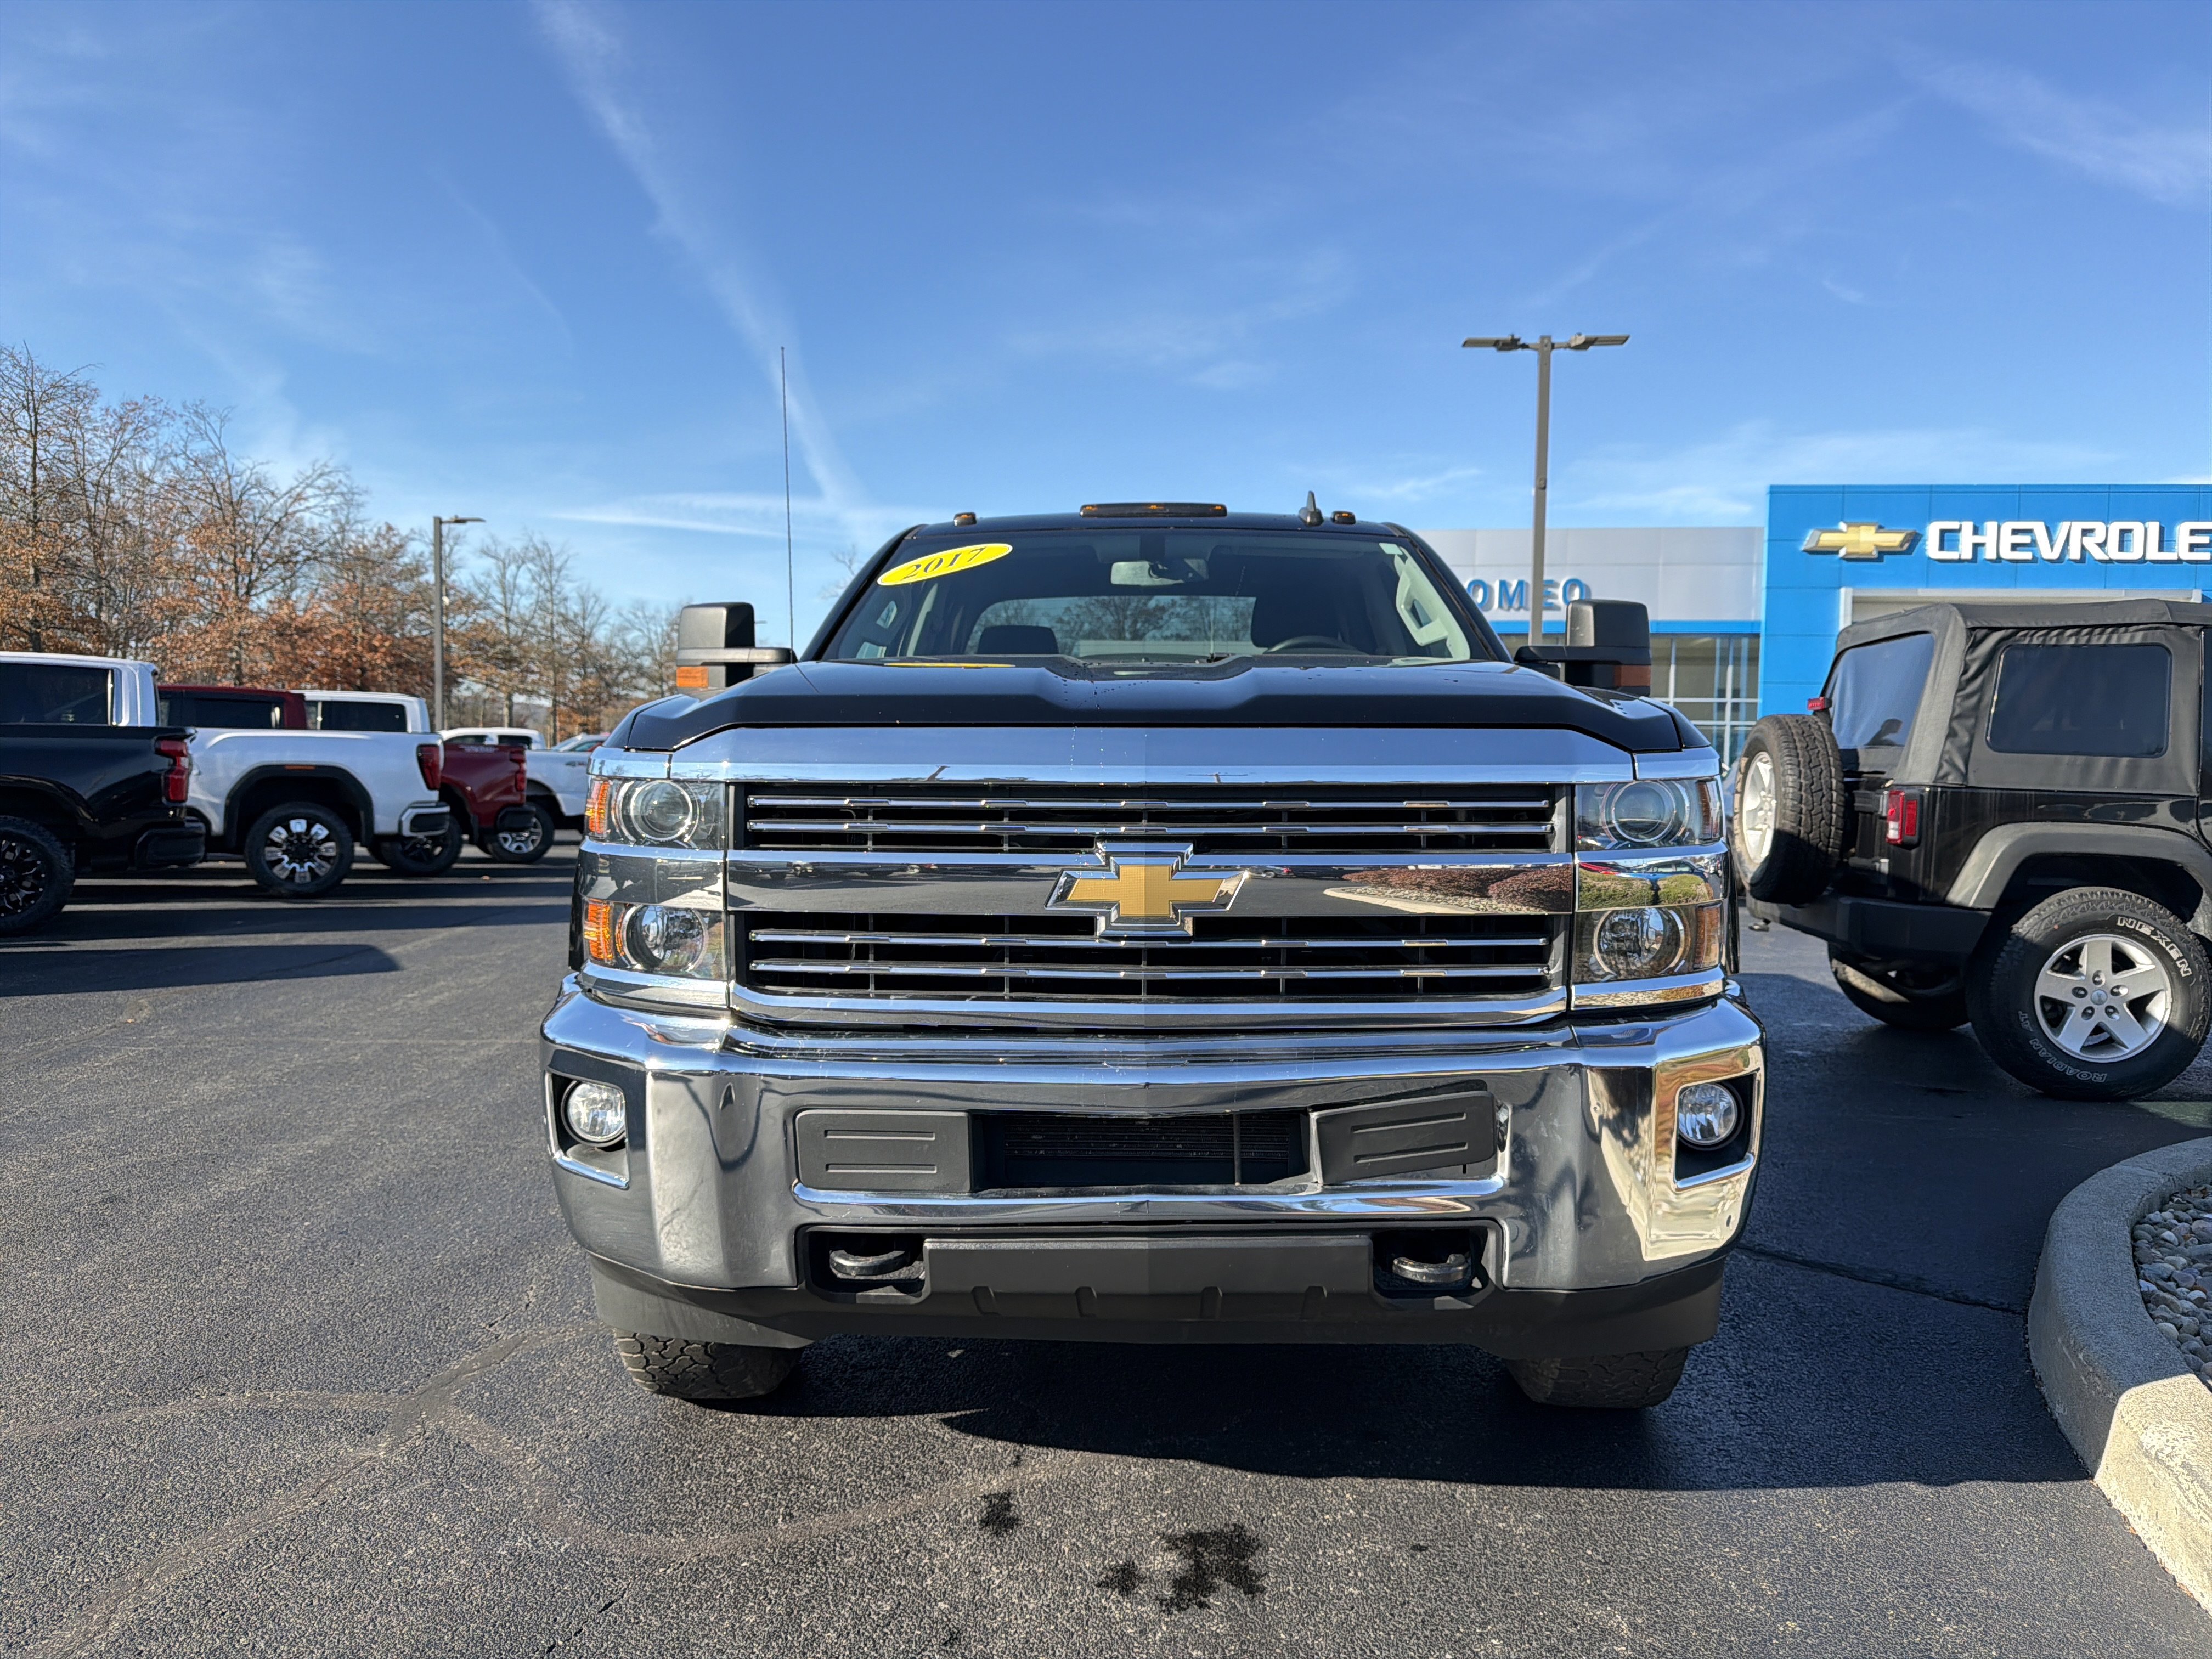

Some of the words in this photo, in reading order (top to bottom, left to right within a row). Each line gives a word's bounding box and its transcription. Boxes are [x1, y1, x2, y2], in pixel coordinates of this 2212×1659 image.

[1927, 521, 2212, 560] CHEVROLE
[900, 546, 987, 582] 2017
[2117, 916, 2192, 977] NEXEN
[2029, 1037, 2107, 1082] ROADIAN
